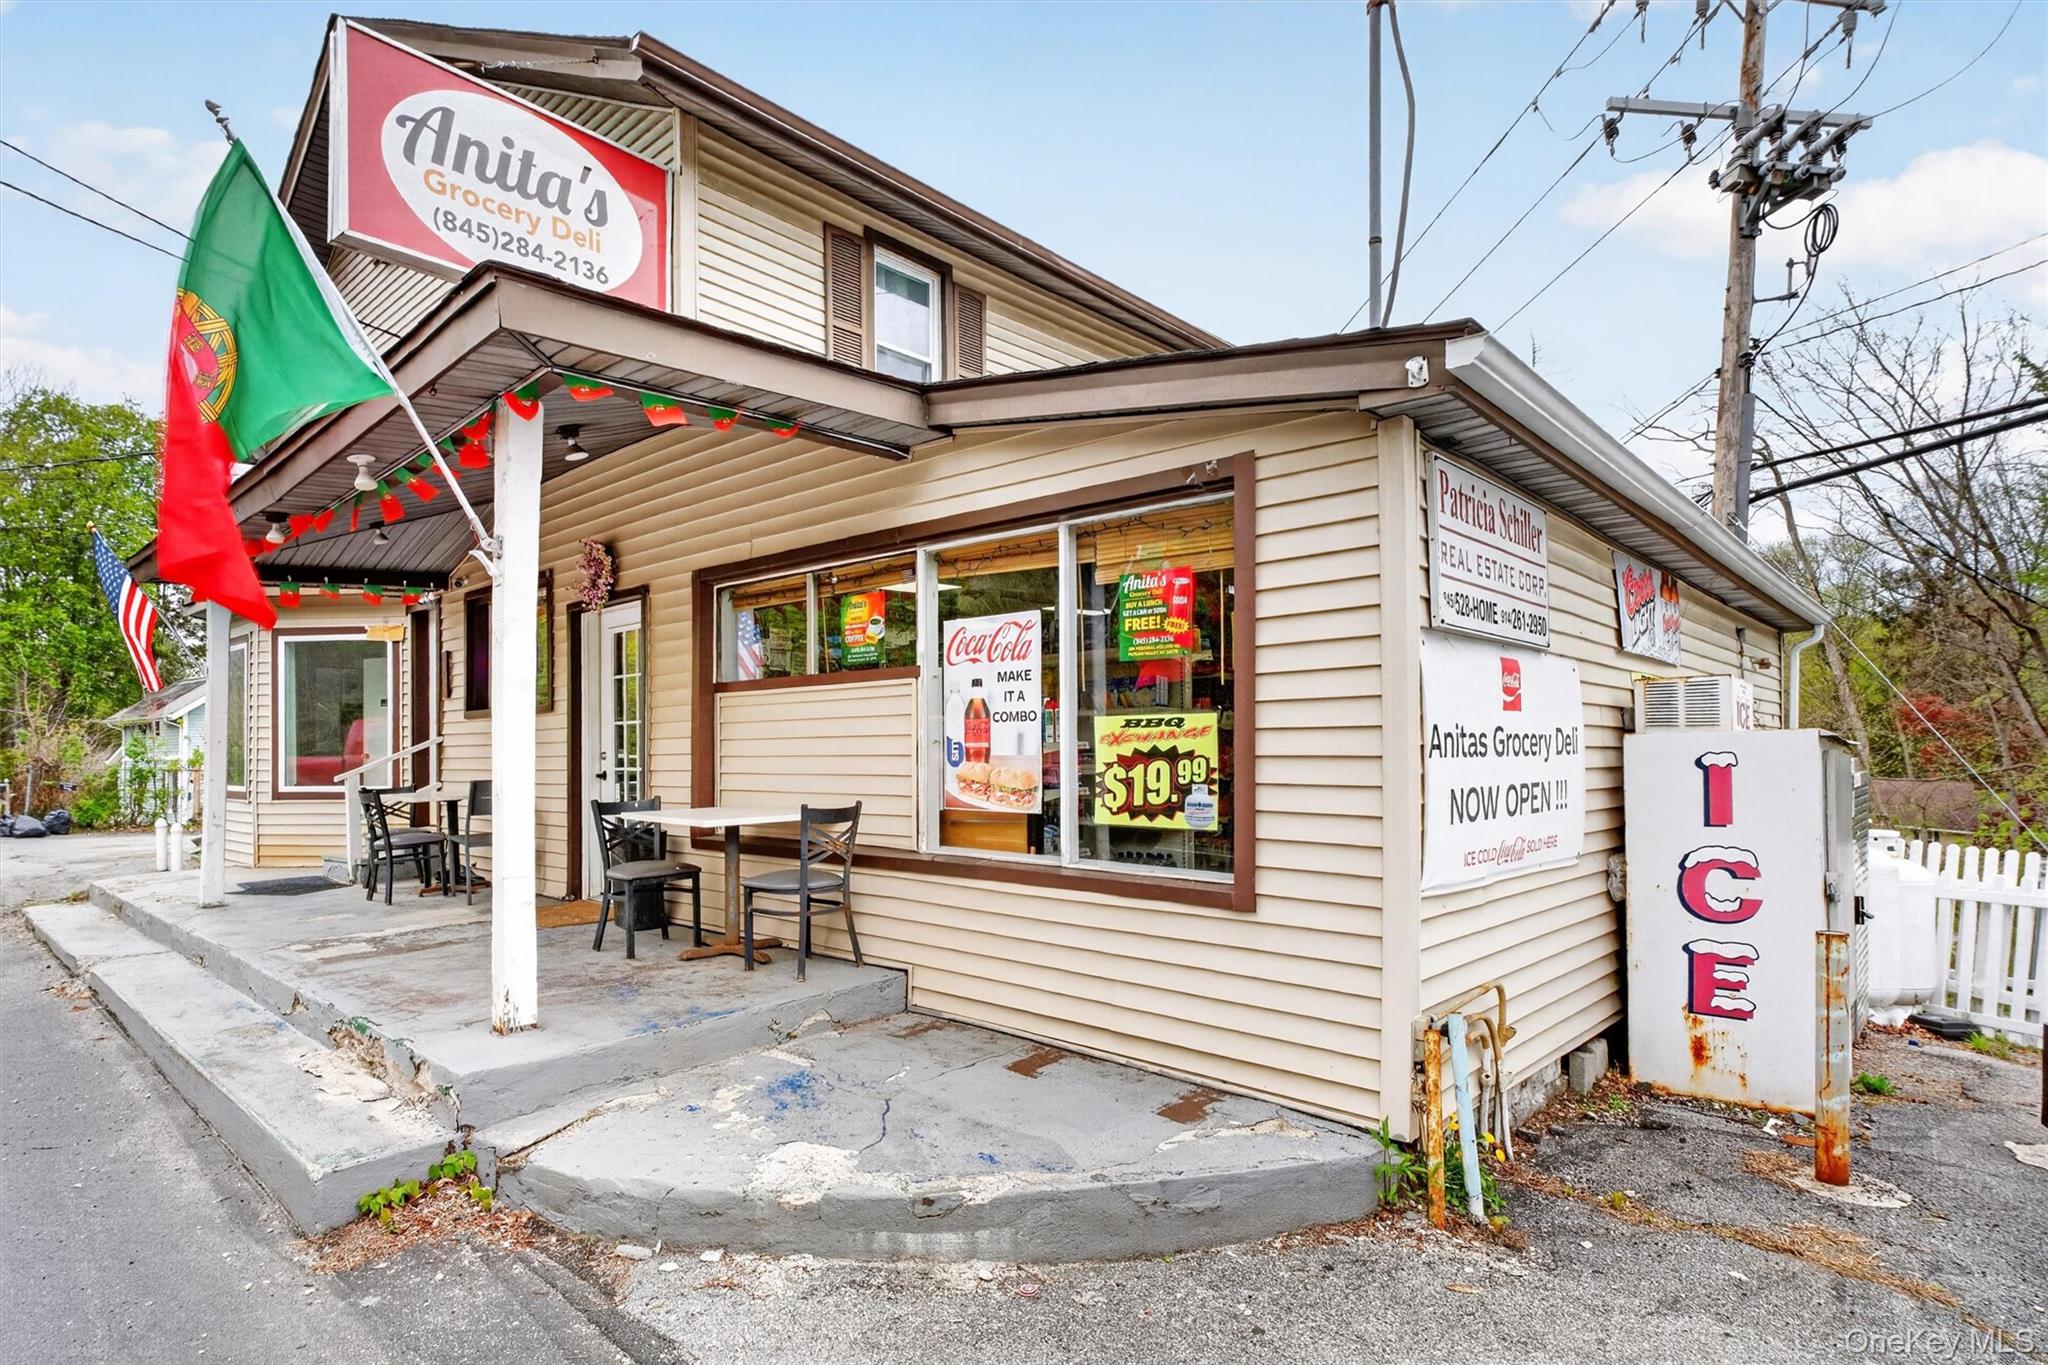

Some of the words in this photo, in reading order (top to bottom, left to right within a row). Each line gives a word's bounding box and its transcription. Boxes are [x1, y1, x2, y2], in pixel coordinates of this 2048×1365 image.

[396, 106, 609, 227] Anita's
[423, 168, 541, 236] Grocery
[552, 215, 602, 254] Deli
[433, 206, 610, 285] (845)284-2136
[1438, 468, 1496, 535] Patricia
[1500, 498, 1543, 554] Schiller
[1123, 572, 1166, 593] Anita's
[1440, 541, 1472, 573] REAL
[1477, 553, 1516, 588] ESTATE
[1518, 566, 1547, 598] CORP.
[1126, 600, 1138, 609] BUY
[1143, 598, 1162, 607] LUNCH
[1125, 616, 1160, 631] FREE!
[946, 618, 1038, 666] Coca-Cola
[997, 669, 1032, 683] MAKE
[1004, 690, 1014, 703] IT
[1016, 690, 1025, 702] A
[992, 710, 1038, 723] COMBO
[1120, 717, 1185, 728] BBQ
[1737, 700, 1750, 729] ICE
[1429, 723, 1487, 758] Anitas
[1493, 726, 1552, 762] Grocery
[1556, 726, 1578, 755] Deli
[1450, 785, 1500, 825] NOW
[1505, 781, 1551, 817] OPEN
[1555, 779, 1568, 810] !!!
[1464, 851, 1476, 867] ICE
[1477, 847, 1498, 864] COLD
[1526, 838, 1542, 853] SOLD
[1544, 834, 1558, 849] HERE
